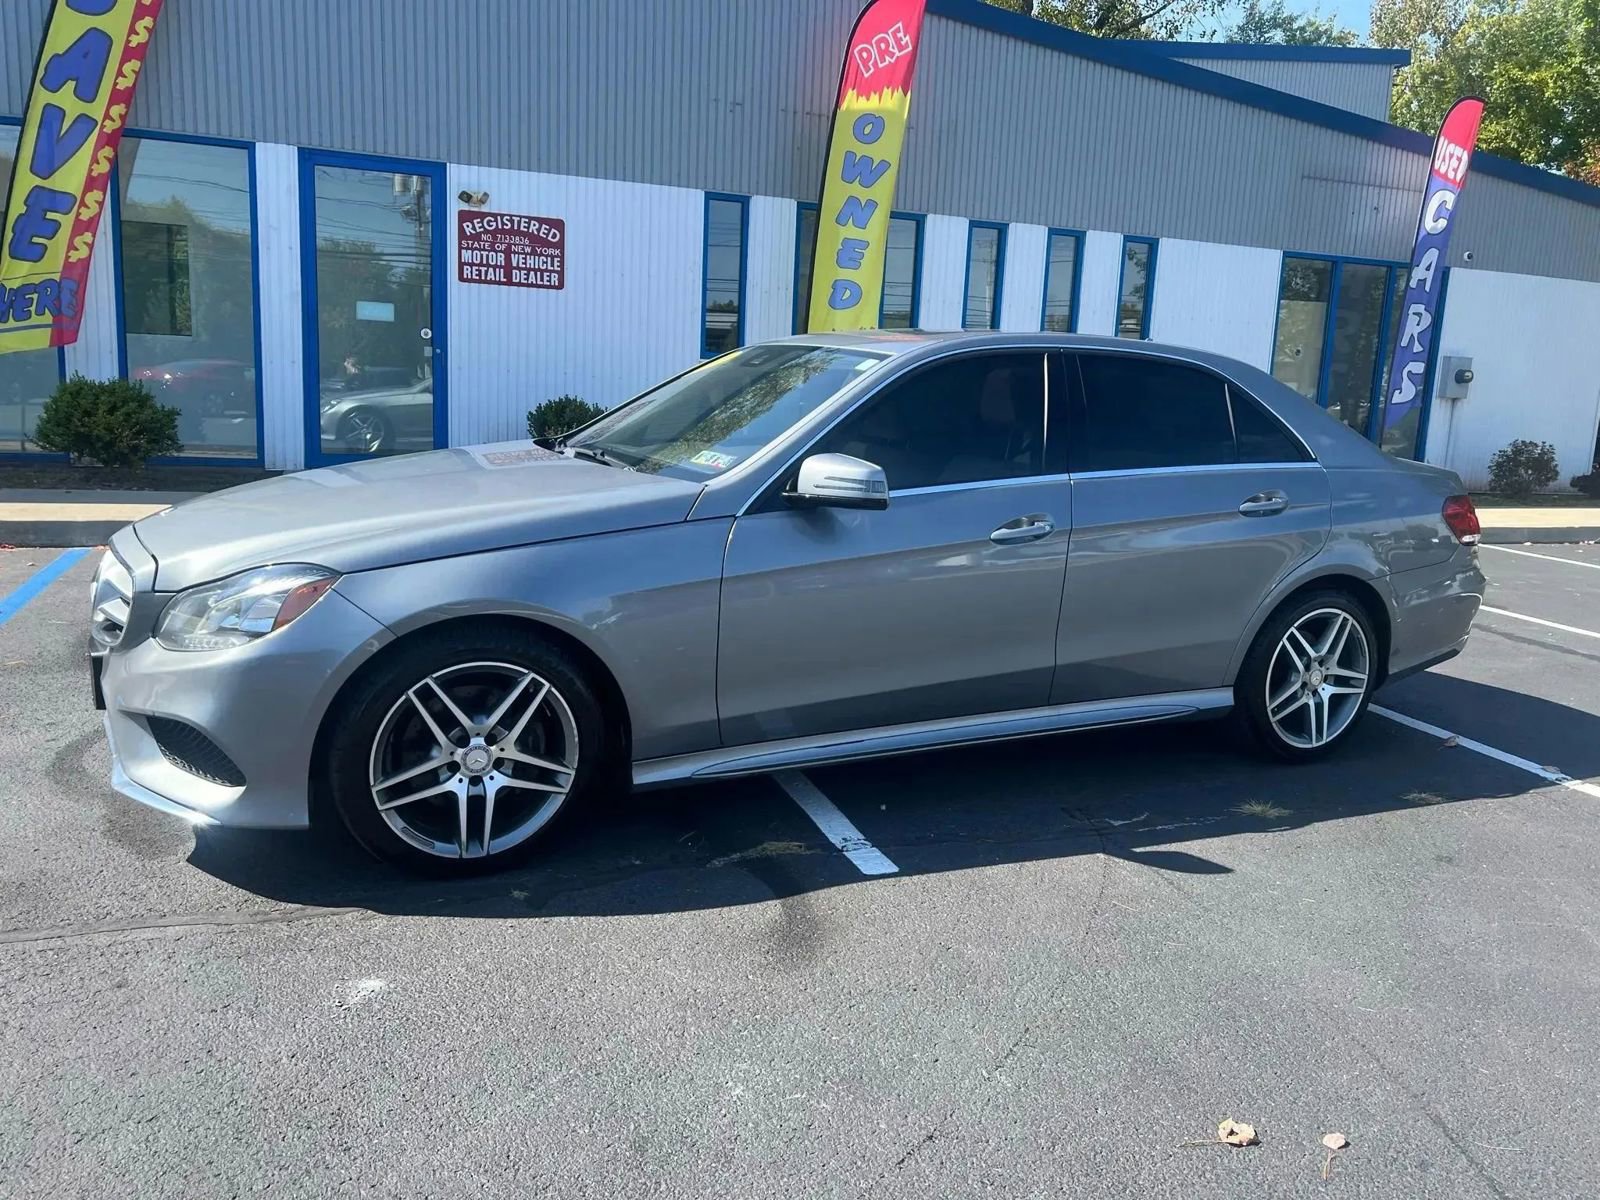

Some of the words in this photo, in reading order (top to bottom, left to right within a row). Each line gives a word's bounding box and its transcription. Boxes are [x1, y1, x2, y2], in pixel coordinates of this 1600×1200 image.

[854, 21, 912, 78] PRE
[8, 0, 118, 262] AVE
[828, 113, 891, 310] OWNED
[462, 216, 560, 242] REGISTERED
[496, 234, 529, 244] 7133836
[461, 241, 490, 249] STATE
[511, 245, 531, 253] NEW
[535, 247, 561, 256] YORK
[461, 250, 504, 266] MOTOR
[511, 254, 561, 270] VEHICLE
[463, 266, 507, 281] RETAIL
[512, 270, 559, 286] DEALER
[1391, 188, 1457, 404] CARS
